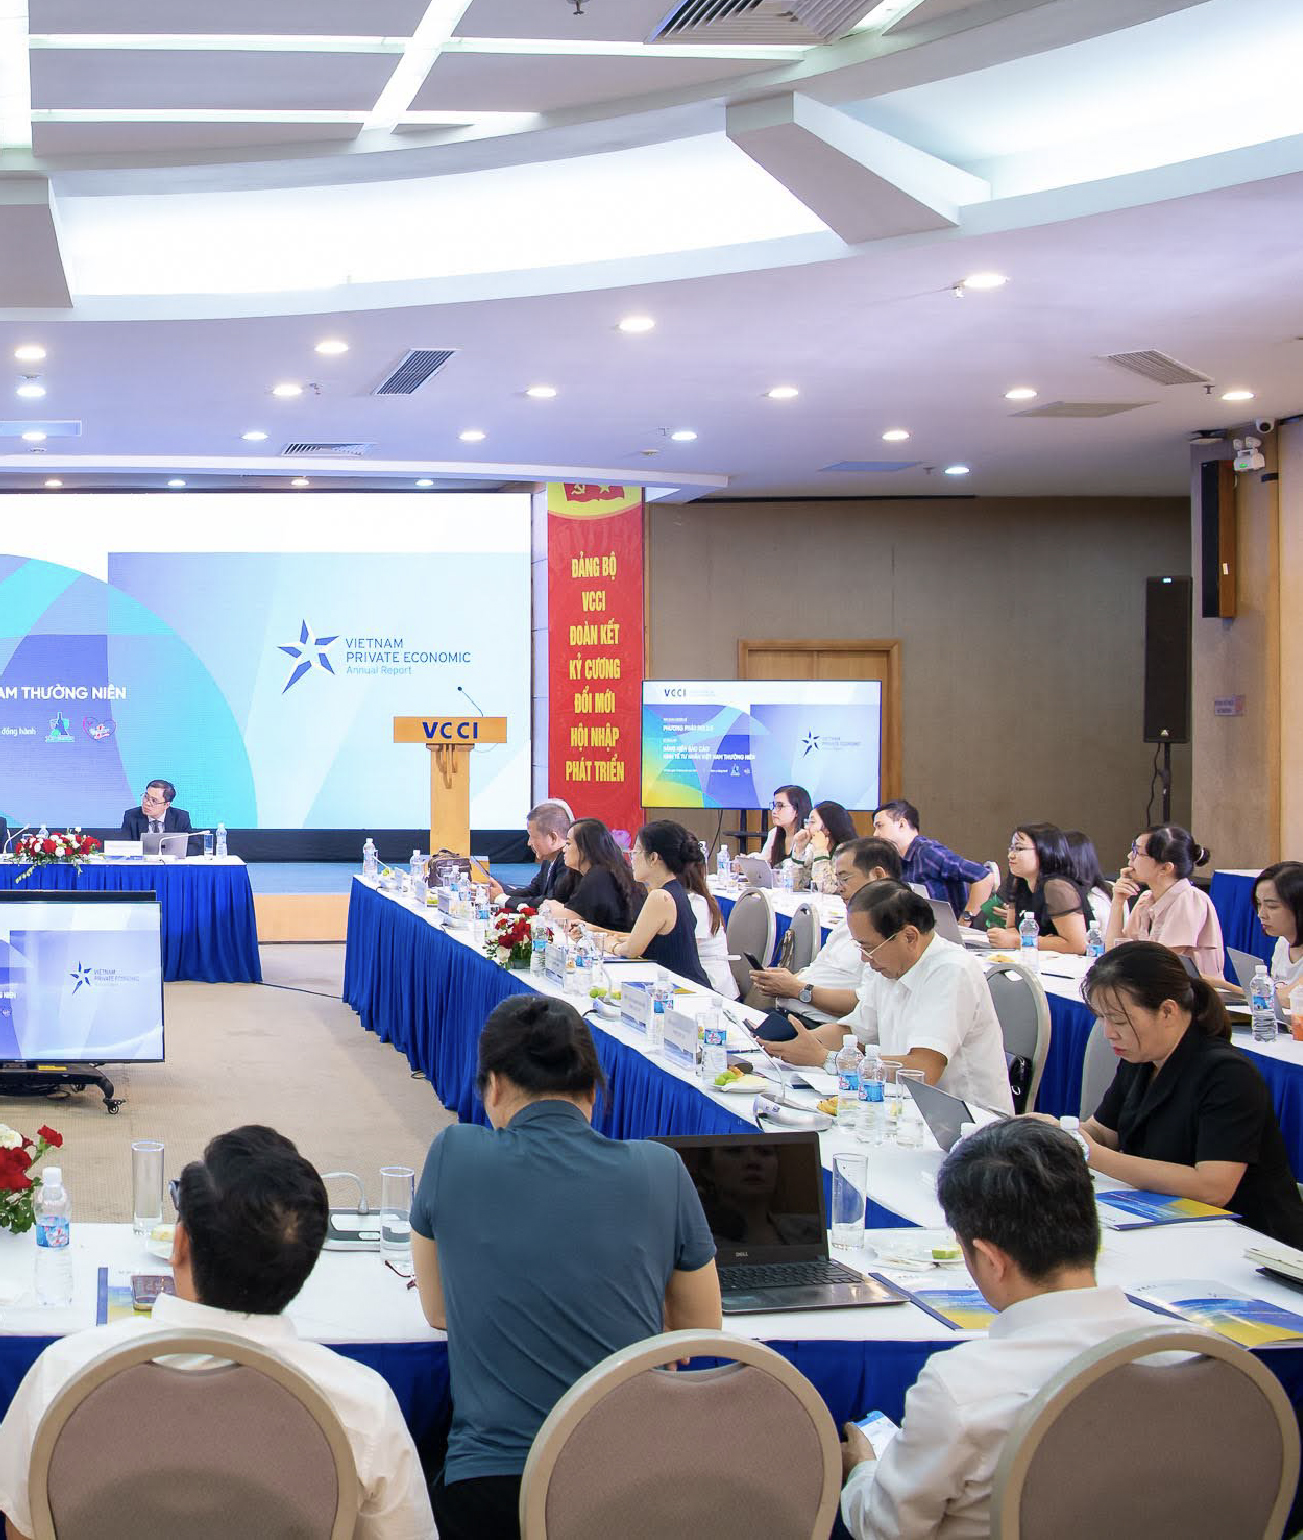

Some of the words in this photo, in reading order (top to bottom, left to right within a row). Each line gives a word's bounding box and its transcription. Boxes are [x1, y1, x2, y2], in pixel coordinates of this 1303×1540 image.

[571, 551, 600, 578] ĐẢNG
[602, 551, 617, 580] BỘ
[582, 591, 606, 612] VCCI
[570, 621, 598, 645] ĐOÀN
[600, 617, 620, 645] KẾT
[346, 638, 403, 649] VIETNAM
[346, 652, 400, 663] PRIVATE
[404, 652, 471, 663] ECONOMIC
[569, 652, 582, 680] KỶ
[585, 656, 621, 680] CƯƠNG
[346, 666, 378, 675] Annual
[381, 666, 412, 676] Report
[21, 683, 88, 700] THƯỜNG
[92, 683, 127, 700] NIÊN
[574, 685, 592, 713] ĐỔI
[595, 690, 615, 713] MỚI
[422, 722, 478, 739] VCCI
[571, 723, 588, 752] HỘI
[591, 723, 619, 752] NHẬP
[566, 757, 592, 782] PHÁT
[594, 754, 625, 782] TRIỂN
